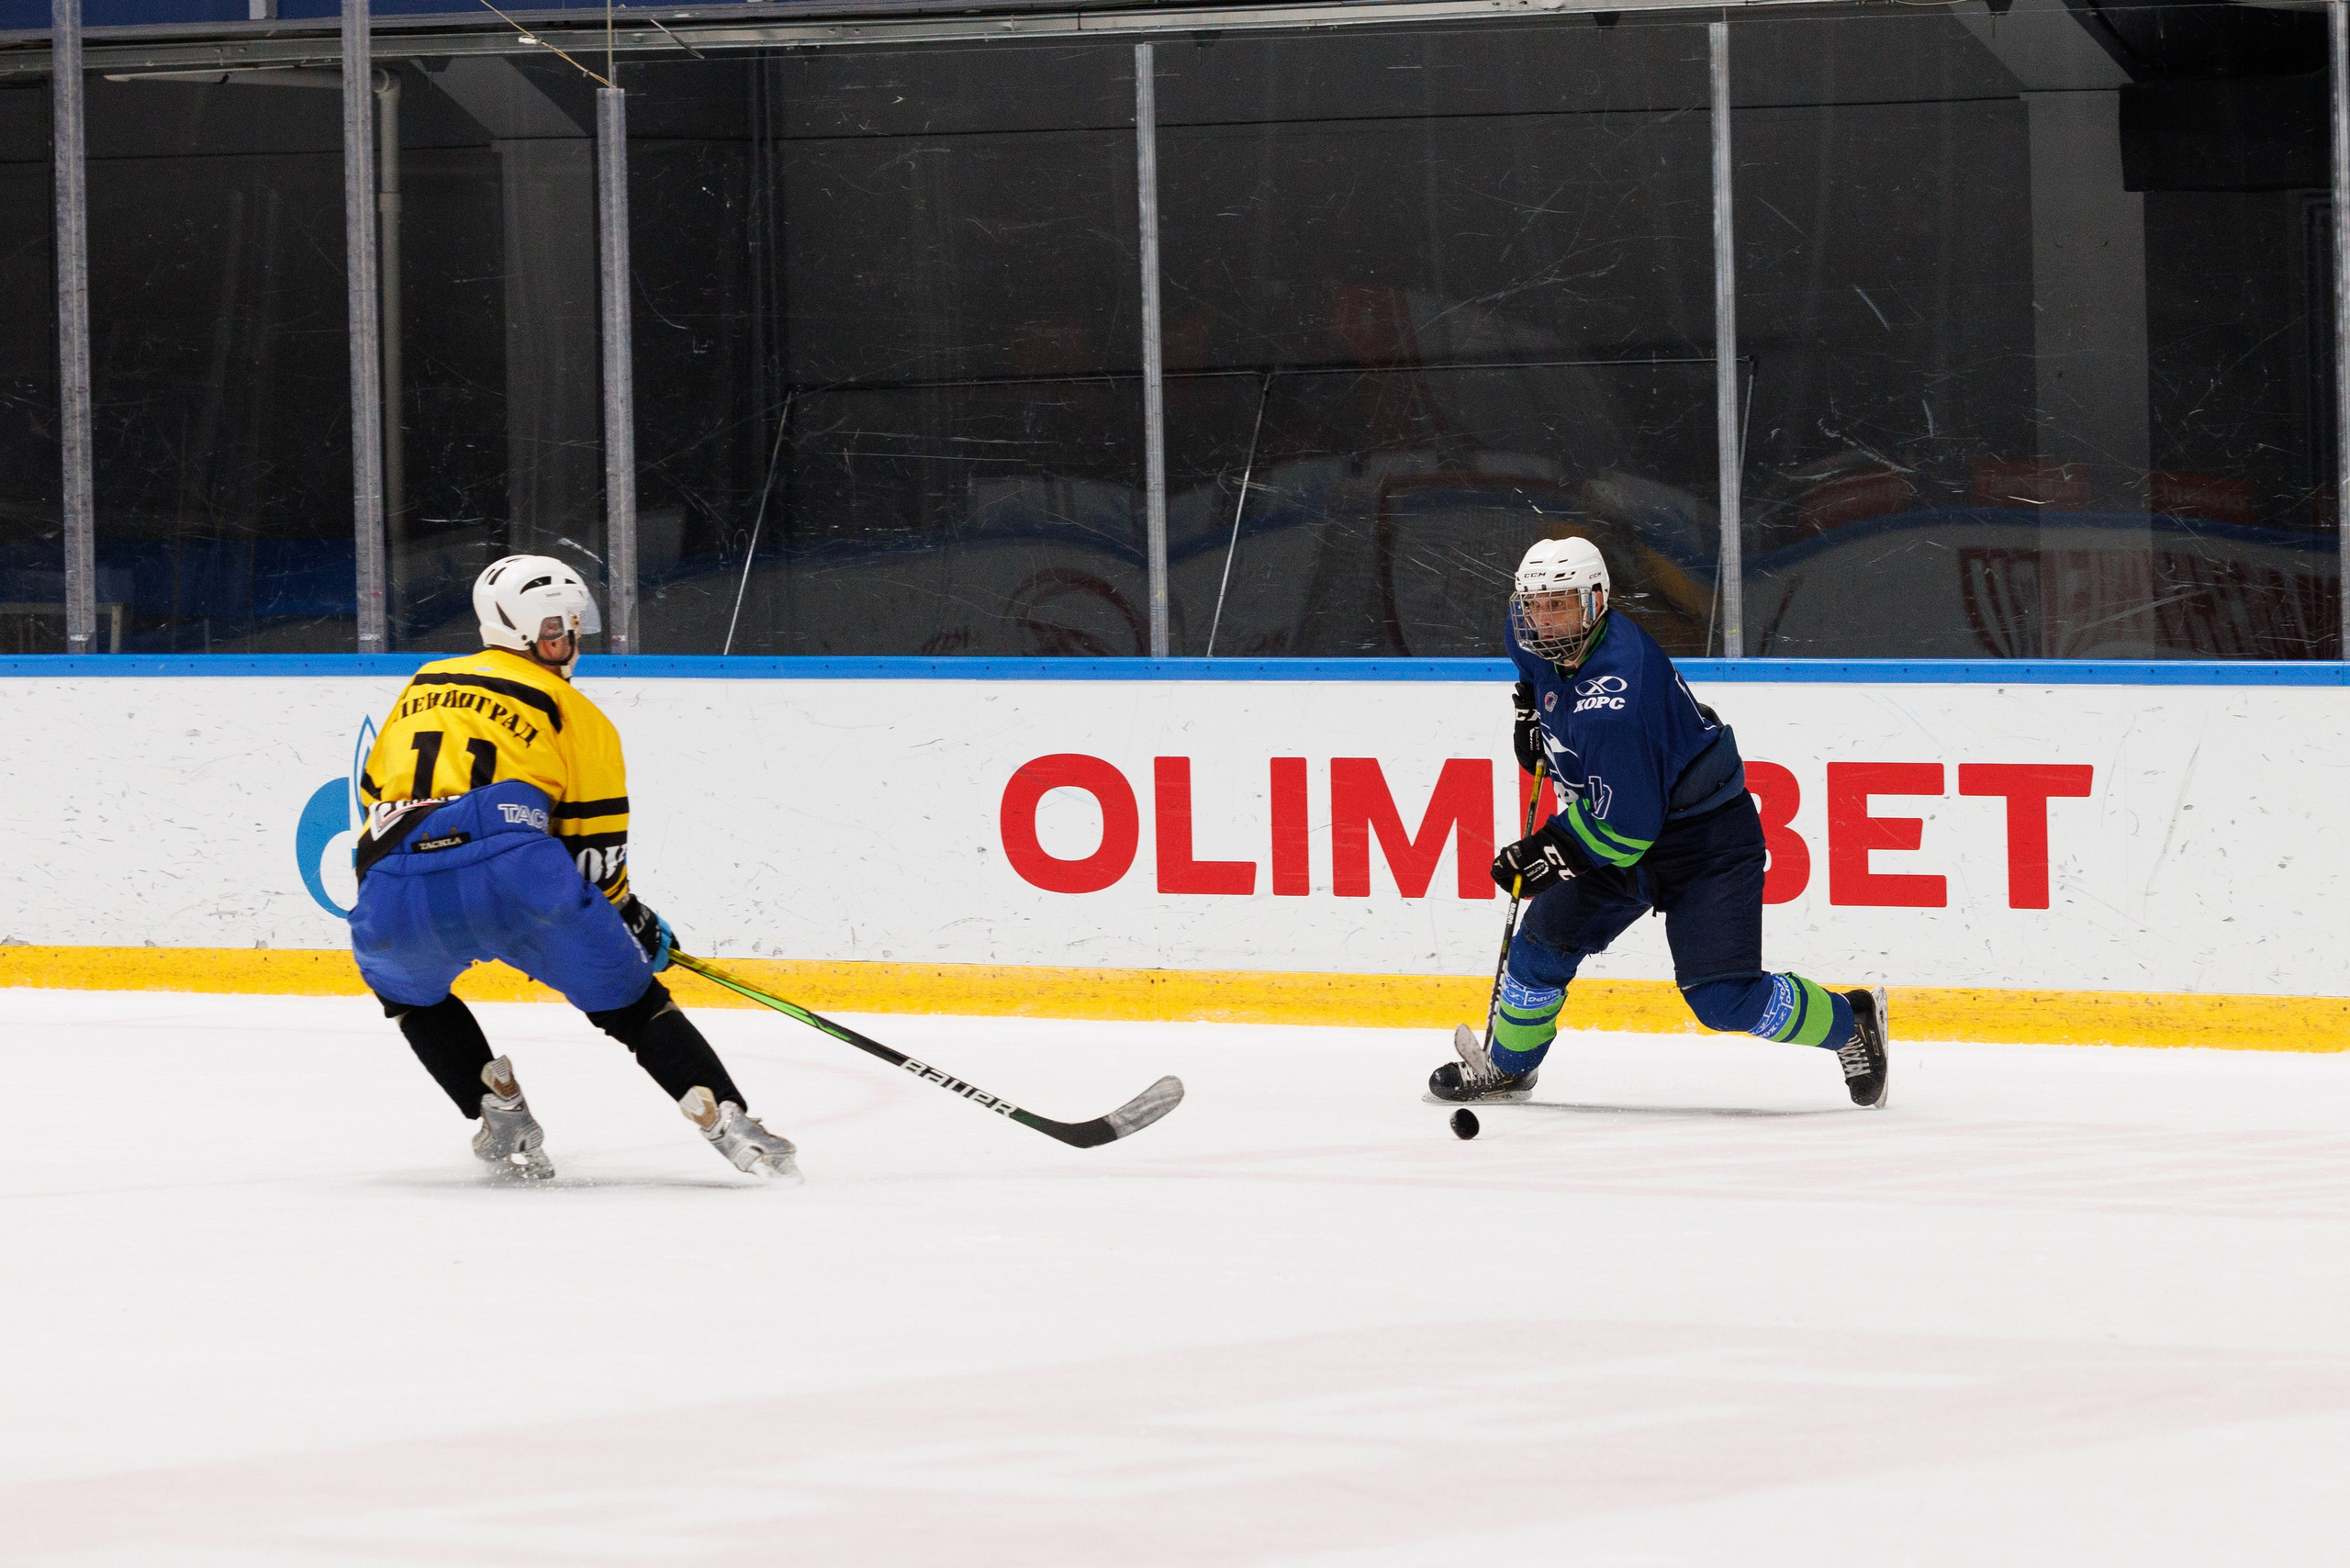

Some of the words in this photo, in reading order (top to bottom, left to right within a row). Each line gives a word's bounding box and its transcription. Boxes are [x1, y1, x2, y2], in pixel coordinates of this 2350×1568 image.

[1589, 572, 1602, 580] CCM
[1572, 696, 1626, 713] ХОРС
[411, 731, 498, 800] 11
[1543, 844, 1577, 880] CC
[901, 1058, 1018, 1118] BAUER
